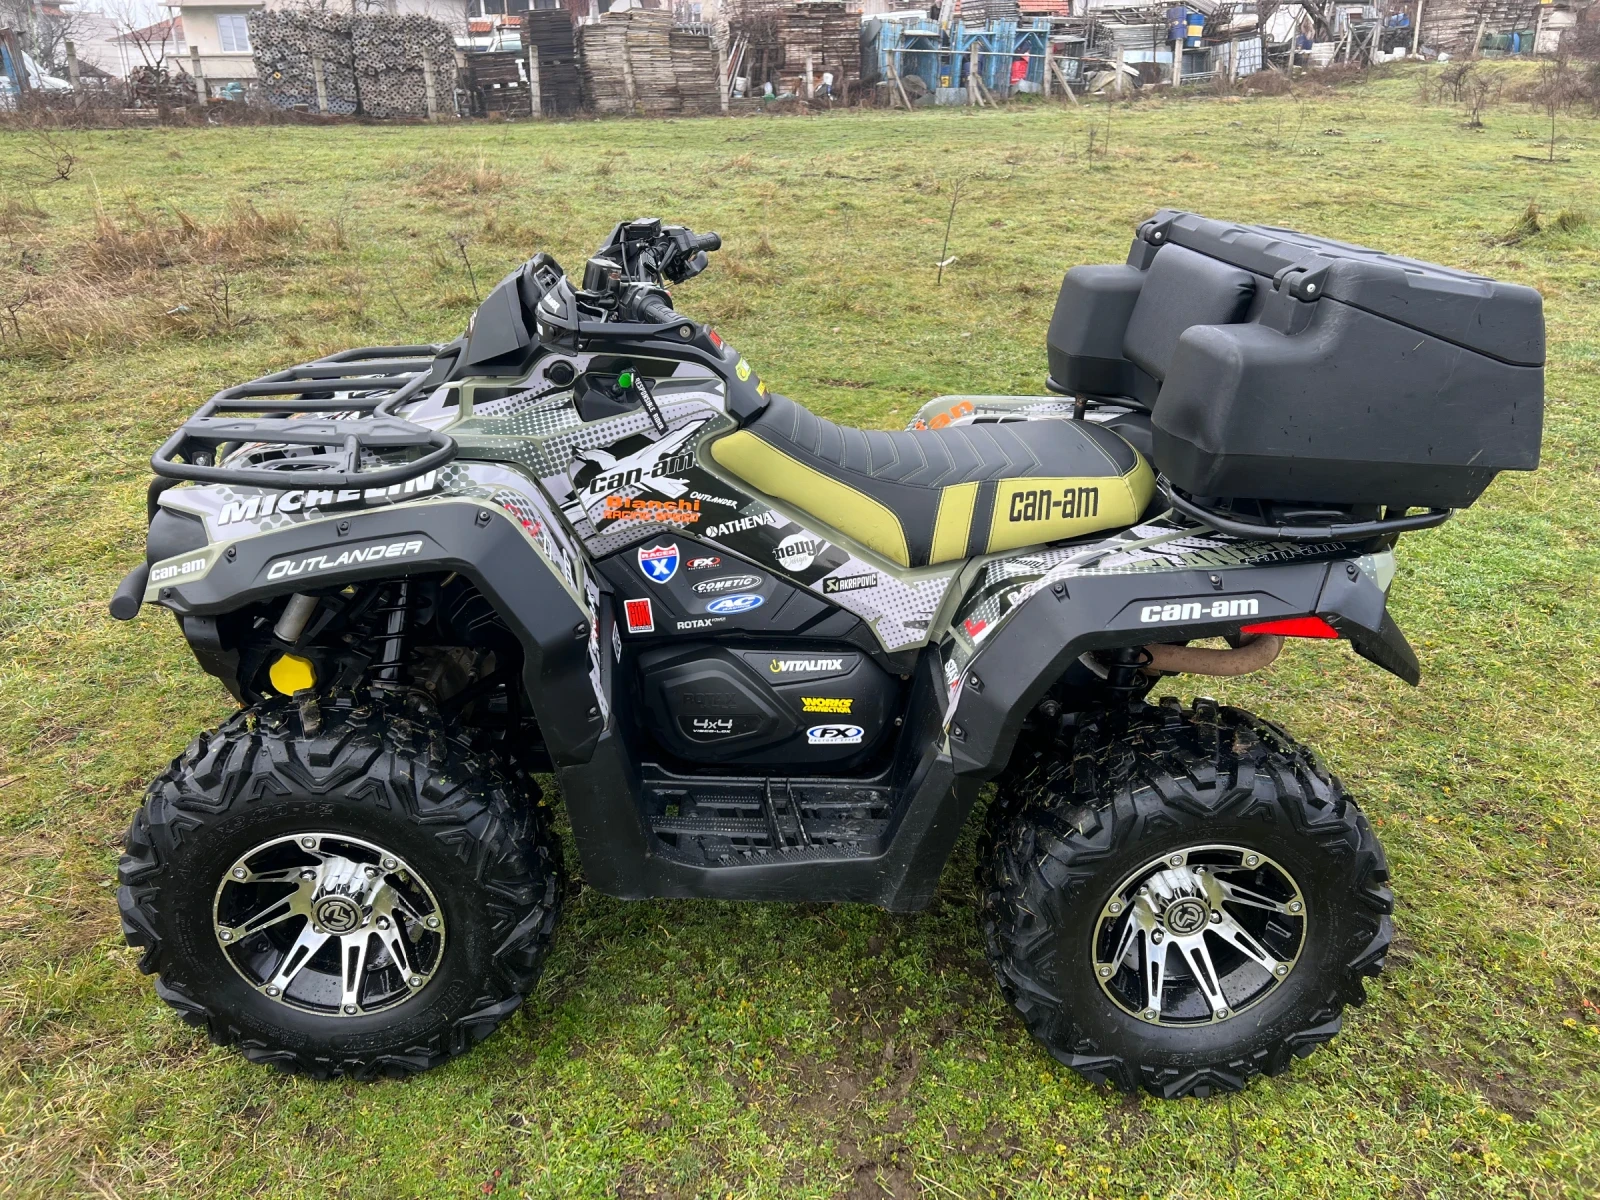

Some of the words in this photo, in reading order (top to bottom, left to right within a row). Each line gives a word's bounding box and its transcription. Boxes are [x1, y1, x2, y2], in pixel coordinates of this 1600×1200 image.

[653, 412, 665, 430] RIDER
[588, 450, 695, 495] can-am
[606, 495, 700, 511] Bianchi
[689, 491, 738, 510] OUTLANDER
[1009, 486, 1099, 523] can-am
[717, 511, 776, 537] ATHENA
[641, 549, 677, 560] RACER
[772, 539, 818, 560] nelly
[266, 539, 425, 582] OUTLANDER
[653, 558, 670, 577] X
[693, 556, 716, 567] FX
[150, 557, 207, 582] can-am
[697, 577, 753, 591] COMETIC
[710, 596, 756, 611] AC
[1140, 598, 1259, 623] can-am
[676, 618, 713, 630] ROTAX
[801, 696, 854, 708] WORKS
[802, 705, 852, 714] CONNECTION
[693, 718, 734, 729] 4x4
[820, 727, 854, 739] FX
